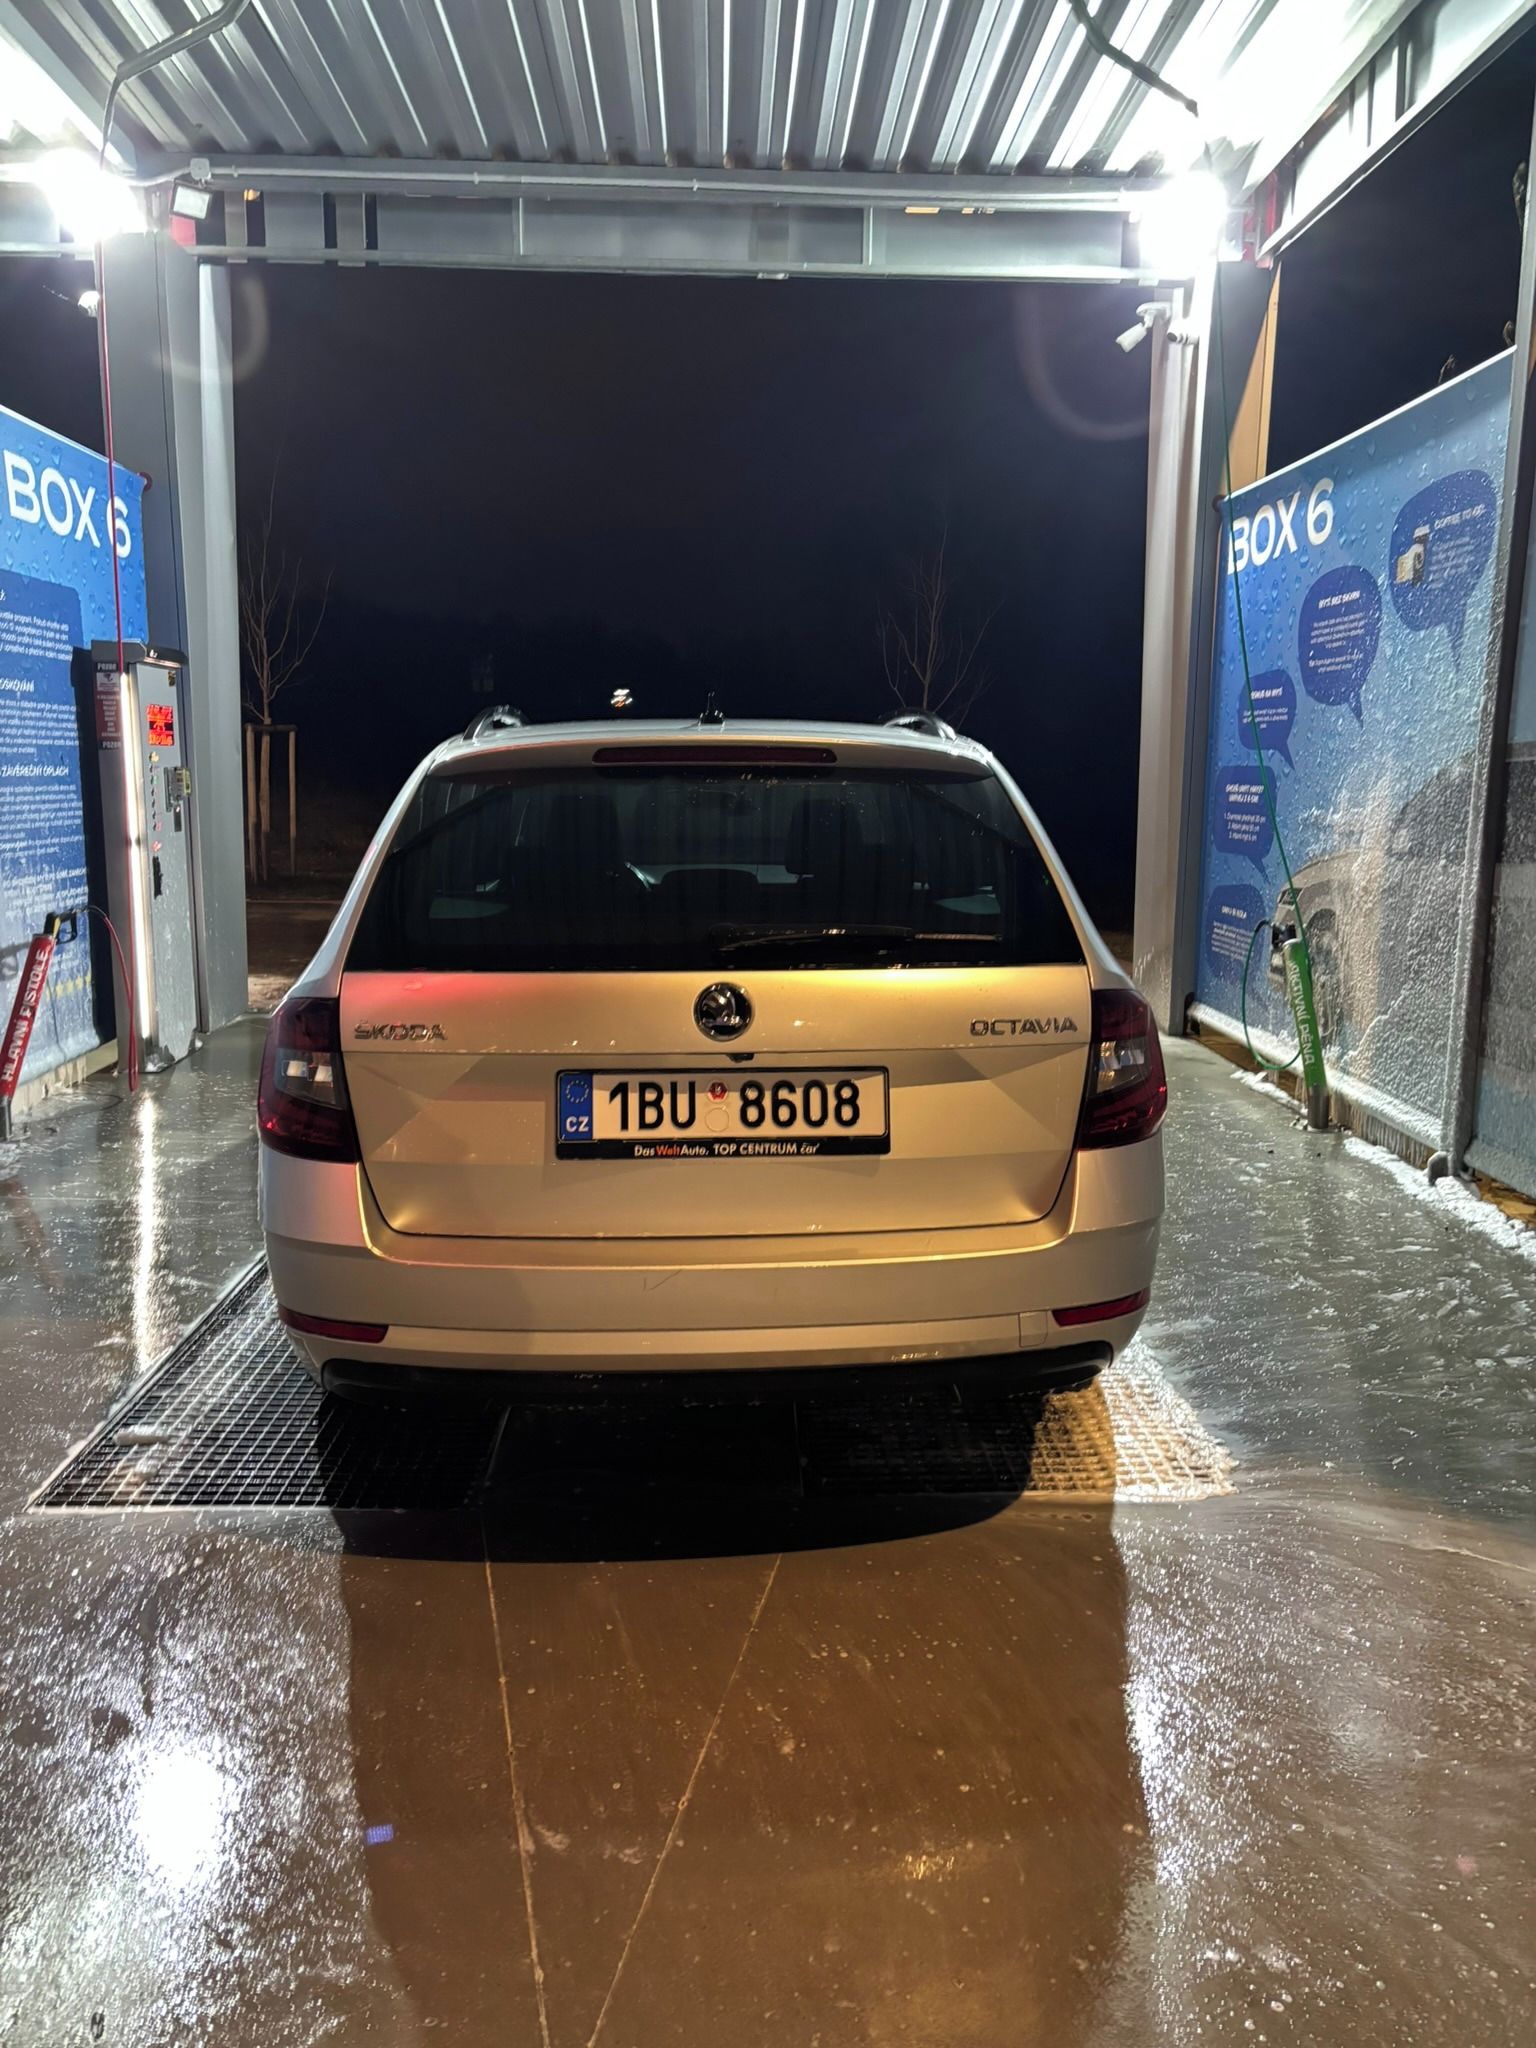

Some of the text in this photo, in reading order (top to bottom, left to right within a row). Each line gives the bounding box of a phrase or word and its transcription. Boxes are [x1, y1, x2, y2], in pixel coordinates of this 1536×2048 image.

[3, 449, 132, 558] BOX 6
[1227, 477, 1335, 576] BOX 6
[19, 948, 49, 1019] PISTOLE
[354, 1019, 447, 1041] ŠKODA
[970, 1017, 1078, 1036] OCTAVIA
[609, 1079, 861, 1131] 1BU 8608
[566, 1115, 590, 1133] CZ
[713, 1143, 737, 1156] TOP
[740, 1142, 797, 1155] CENTRUM
